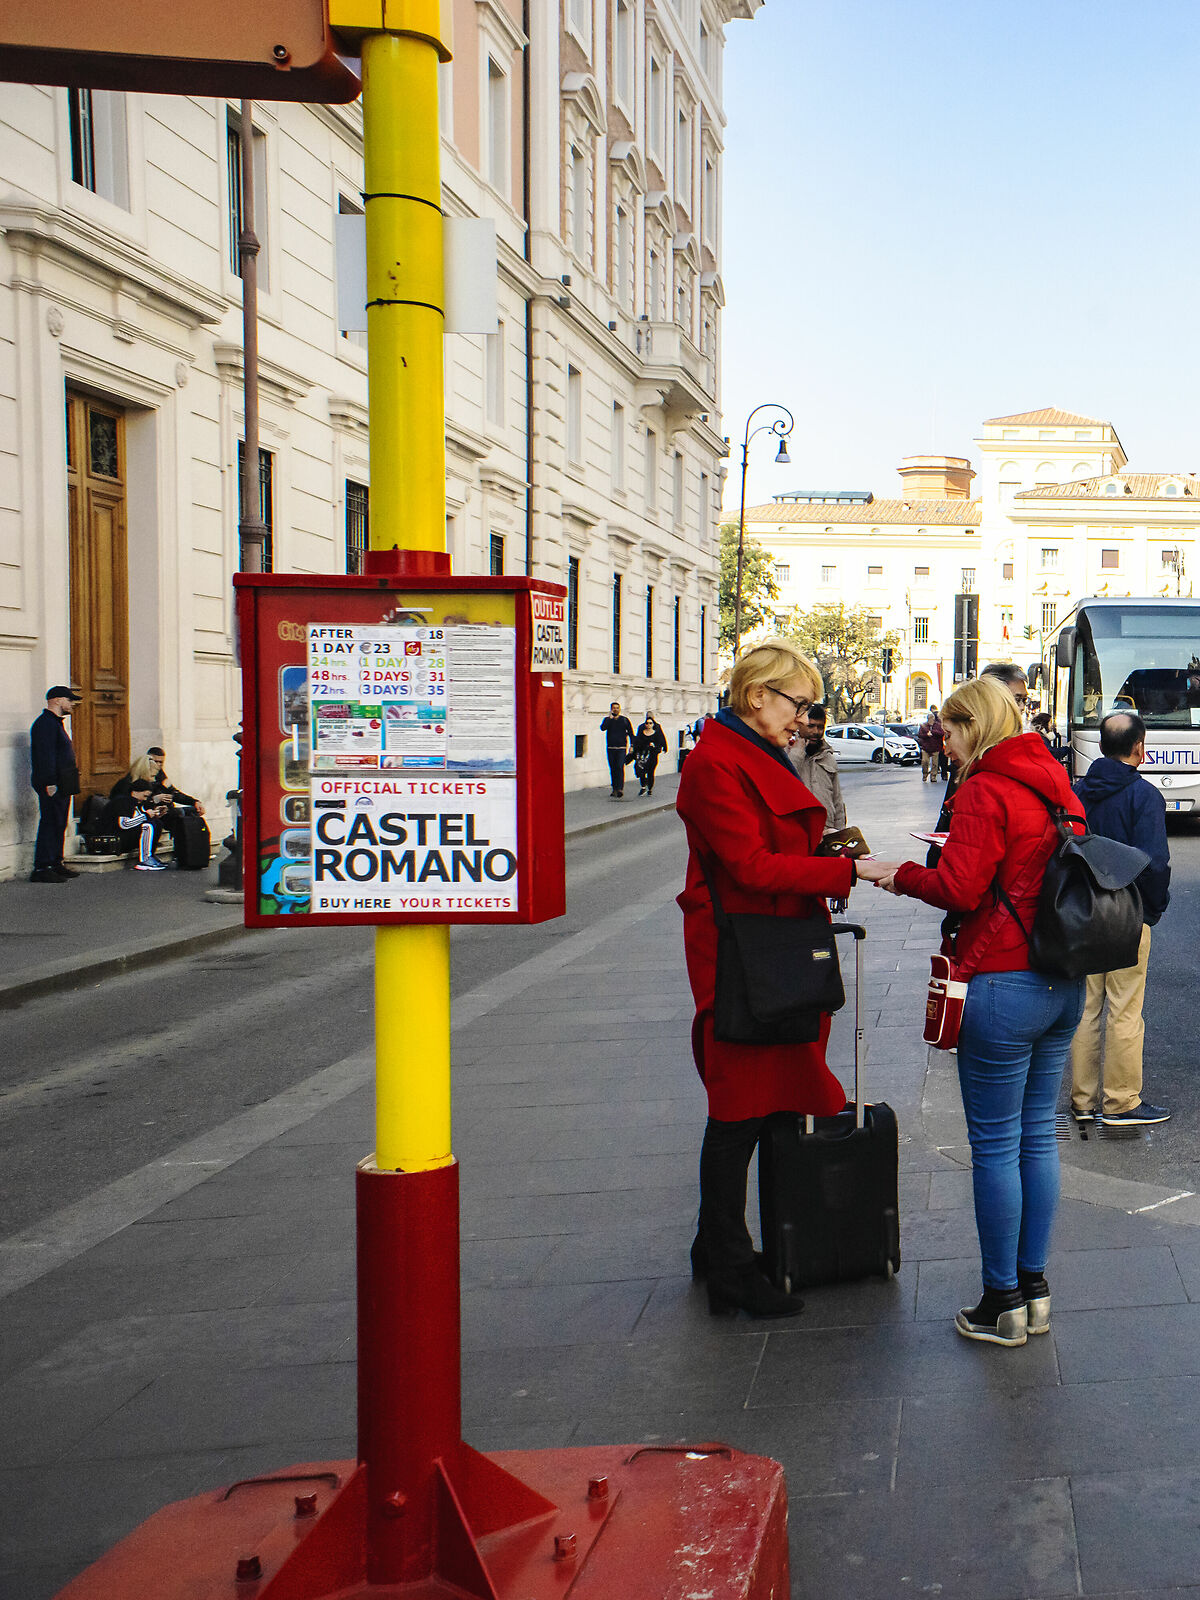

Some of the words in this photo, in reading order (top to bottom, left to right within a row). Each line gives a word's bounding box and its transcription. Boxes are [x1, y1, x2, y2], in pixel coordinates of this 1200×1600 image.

[534, 598, 564, 619] OUTLET
[310, 629, 354, 639] AFTER
[537, 624, 562, 643] CASTEL
[312, 643, 318, 653] 1
[324, 643, 355, 653] DAY
[312, 657, 328, 667] 24
[534, 647, 564, 665] ROMANO
[312, 671, 329, 681] 48
[321, 781, 402, 794] OFFICIAL
[408, 782, 487, 795] TICKETS
[316, 812, 490, 846] CASTEL
[314, 848, 518, 883] ROMANO
[320, 898, 350, 909] BUY
[354, 898, 391, 909] HERE
[400, 898, 441, 908] YOUR
[446, 897, 511, 908] TICKETS
